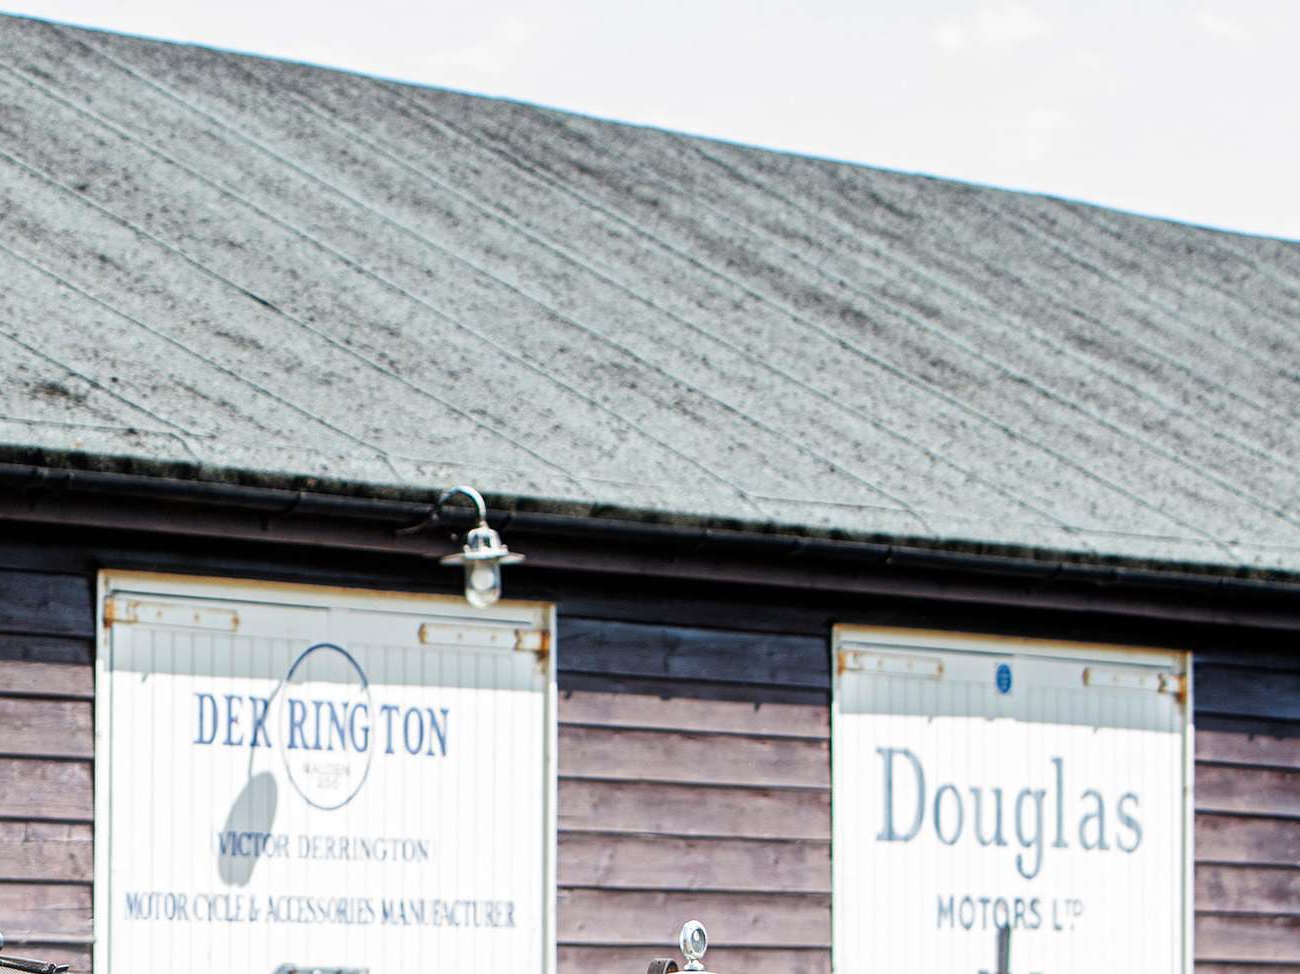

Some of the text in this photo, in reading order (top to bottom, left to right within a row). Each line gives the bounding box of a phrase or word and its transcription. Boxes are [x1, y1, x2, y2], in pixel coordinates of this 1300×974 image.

[875, 746, 1144, 879] Douglas
[218, 831, 431, 863] VICTOR DERRINGTON
[125, 891, 191, 922] MOTOR
[248, 898, 262, 922] &
[264, 895, 376, 926] ACCESSORIES
[381, 897, 517, 928] MANUFACTURER
[937, 894, 1042, 930] MOTORS
